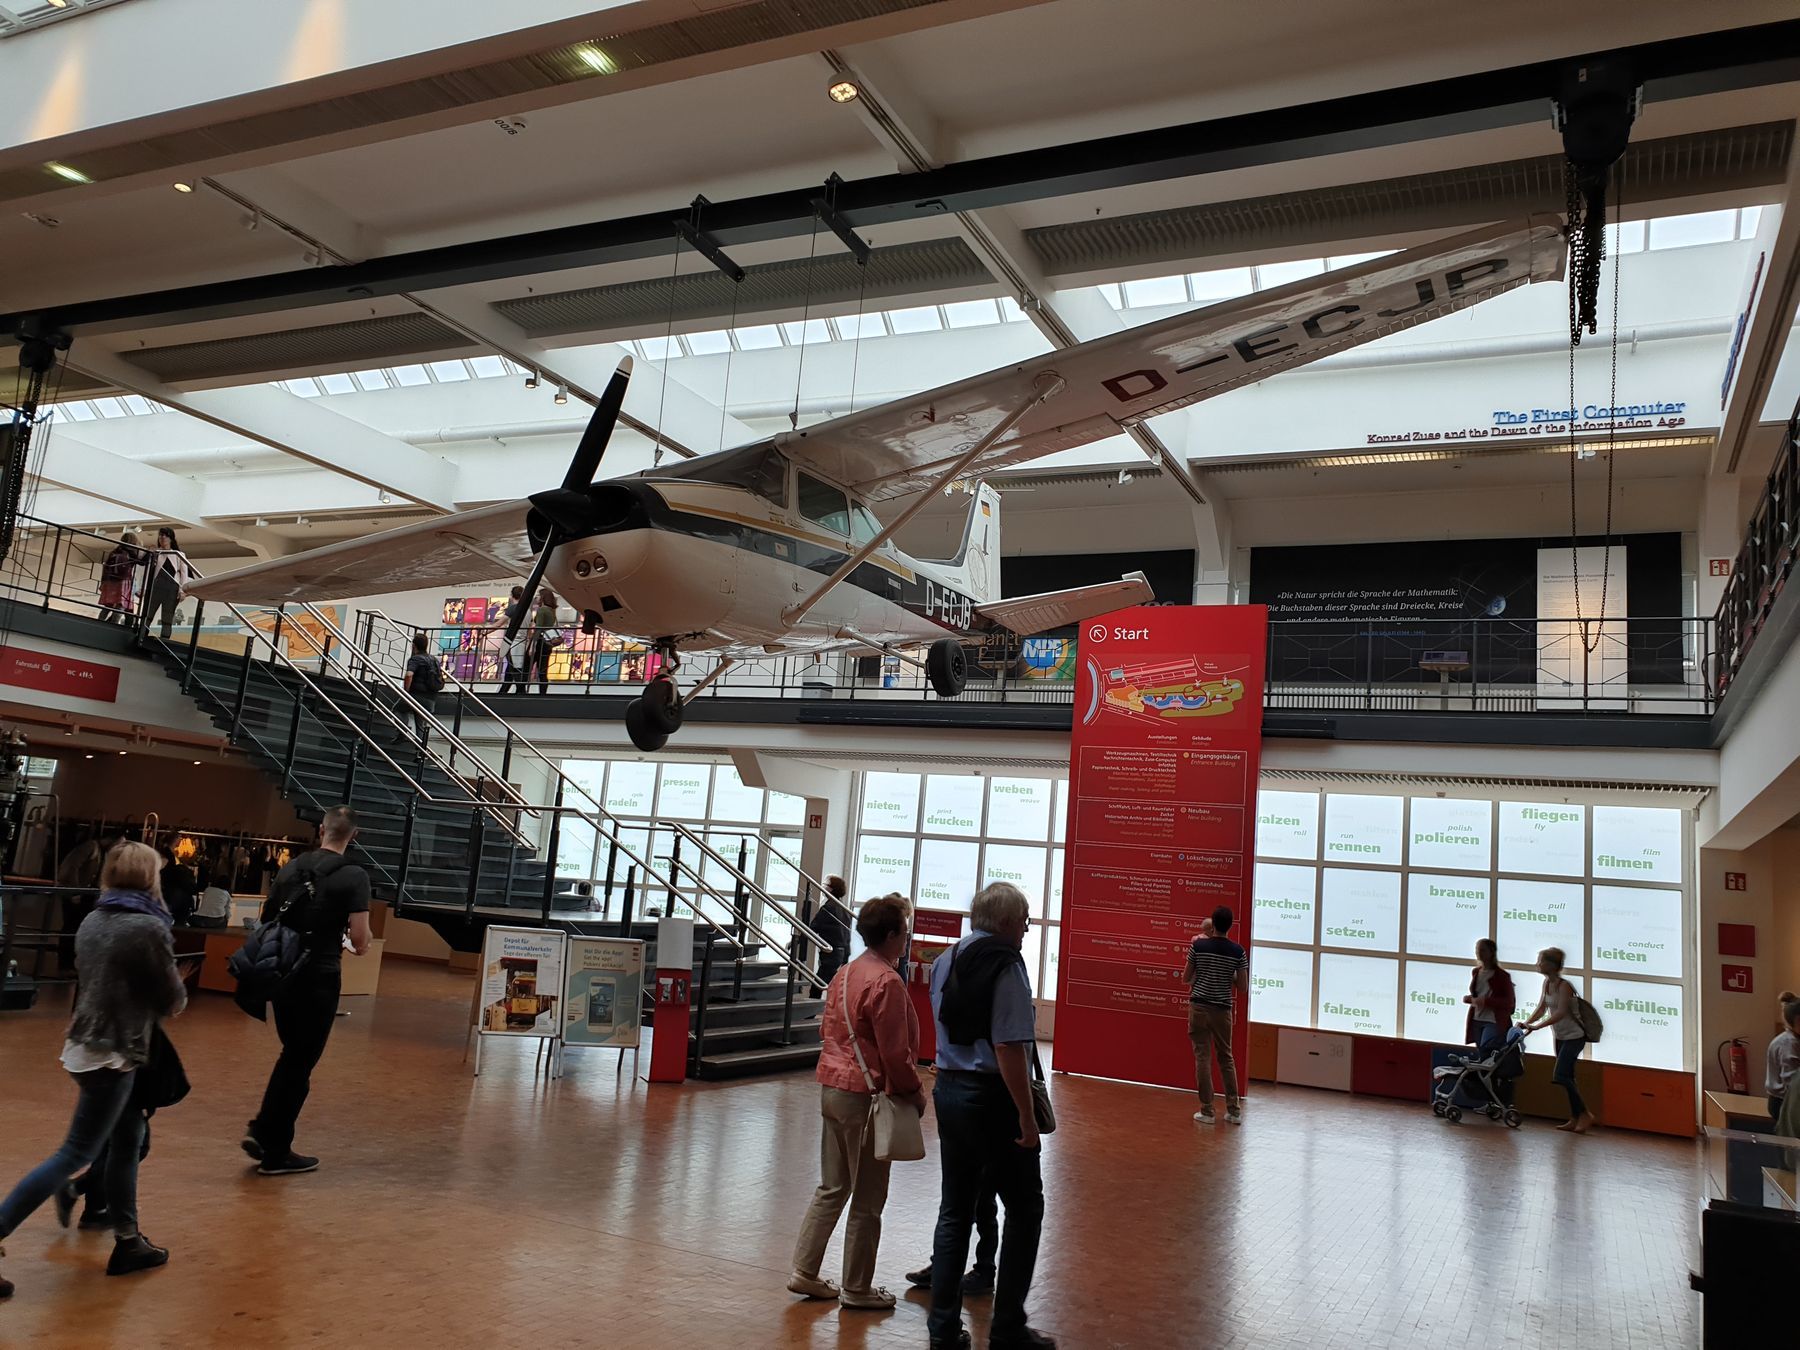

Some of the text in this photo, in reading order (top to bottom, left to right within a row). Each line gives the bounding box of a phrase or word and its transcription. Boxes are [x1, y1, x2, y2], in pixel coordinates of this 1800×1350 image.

[1493, 401, 1686, 424] The First Computer
[1367, 416, 1686, 443] Konrad Zuse and the Dawn of the Information Age
[1295, 591, 1317, 599] Natur
[1319, 590, 1345, 600] spricht
[1347, 590, 1358, 598] die
[1360, 590, 1391, 600] Sprache
[1392, 589, 1406, 598] der
[1407, 588, 1459, 598] Mathematik:
[926, 579, 971, 630] D-ECJB
[1267, 601, 1464, 613] Die Buchstaben dieser Sprache sind Dreiecke, Kreise
[1114, 627, 1149, 640] Start
[15, 659, 40, 669] Fahrstuhl
[1191, 752, 1240, 761] Eingangsgebäude
[663, 778, 700, 787] pressen
[993, 784, 1033, 795] weben
[608, 798, 638, 807] radeln
[866, 800, 901, 811] nieten
[1187, 807, 1210, 815] Neubau
[1521, 807, 1580, 823] fliegen
[926, 815, 974, 827] drucken
[1257, 814, 1301, 826] alzen
[1447, 823, 1473, 833] polish
[1534, 823, 1546, 832] fly
[1414, 831, 1480, 846] polieren
[1328, 841, 1382, 853] rennen
[1642, 848, 1661, 857] film
[863, 854, 911, 867] bremsen
[1186, 855, 1223, 863] Lokschuppen
[1596, 854, 1654, 870] filmen
[987, 867, 1023, 880] hören
[1185, 880, 1224, 888] Beamtenhaus
[920, 888, 950, 900] löten
[1429, 885, 1485, 900] brauen
[1254, 898, 1311, 911] prechen
[1455, 902, 1477, 910] brew
[1548, 902, 1567, 911] pull
[1351, 917, 1364, 925] set
[1503, 908, 1558, 923] ziehen
[1326, 924, 1376, 939] setzen
[504, 944, 552, 953] Kommunalverkehr
[1627, 940, 1665, 950] conduct
[1596, 946, 1648, 962] leiten
[1251, 974, 1285, 988] ägen
[1410, 990, 1456, 1006] feilen
[1323, 1001, 1371, 1018] falzen
[1425, 1007, 1439, 1015] file
[1603, 998, 1679, 1016] abfüllen
[1354, 1021, 1382, 1030] groove
[1639, 1016, 1669, 1027] bottle
